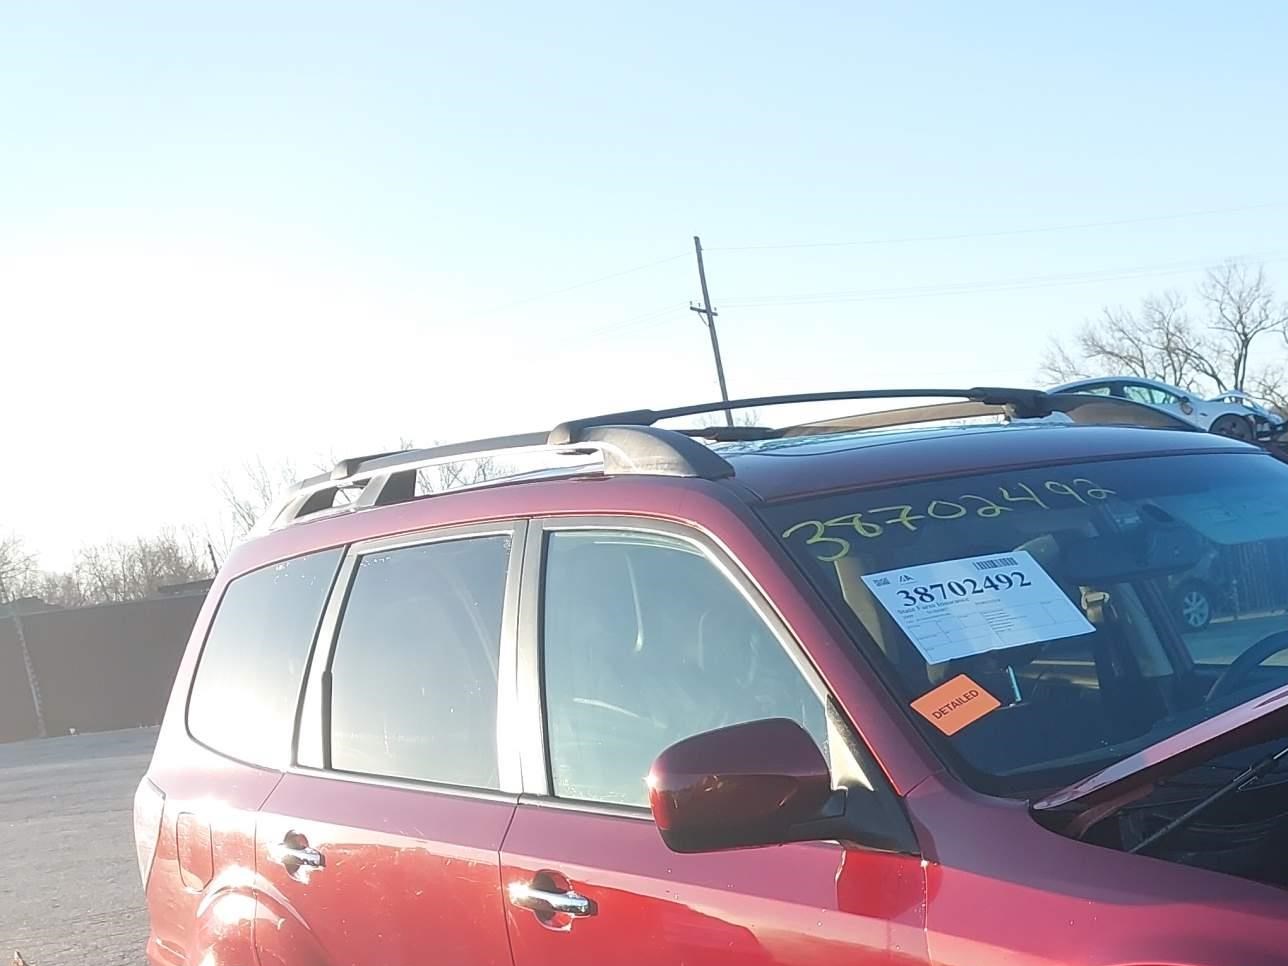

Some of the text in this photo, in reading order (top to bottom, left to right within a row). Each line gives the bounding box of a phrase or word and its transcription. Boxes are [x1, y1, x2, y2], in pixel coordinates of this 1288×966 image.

[783, 478, 1116, 561] 38702492
[896, 571, 1032, 607] 38702492
[931, 688, 980, 721] DETAILED
